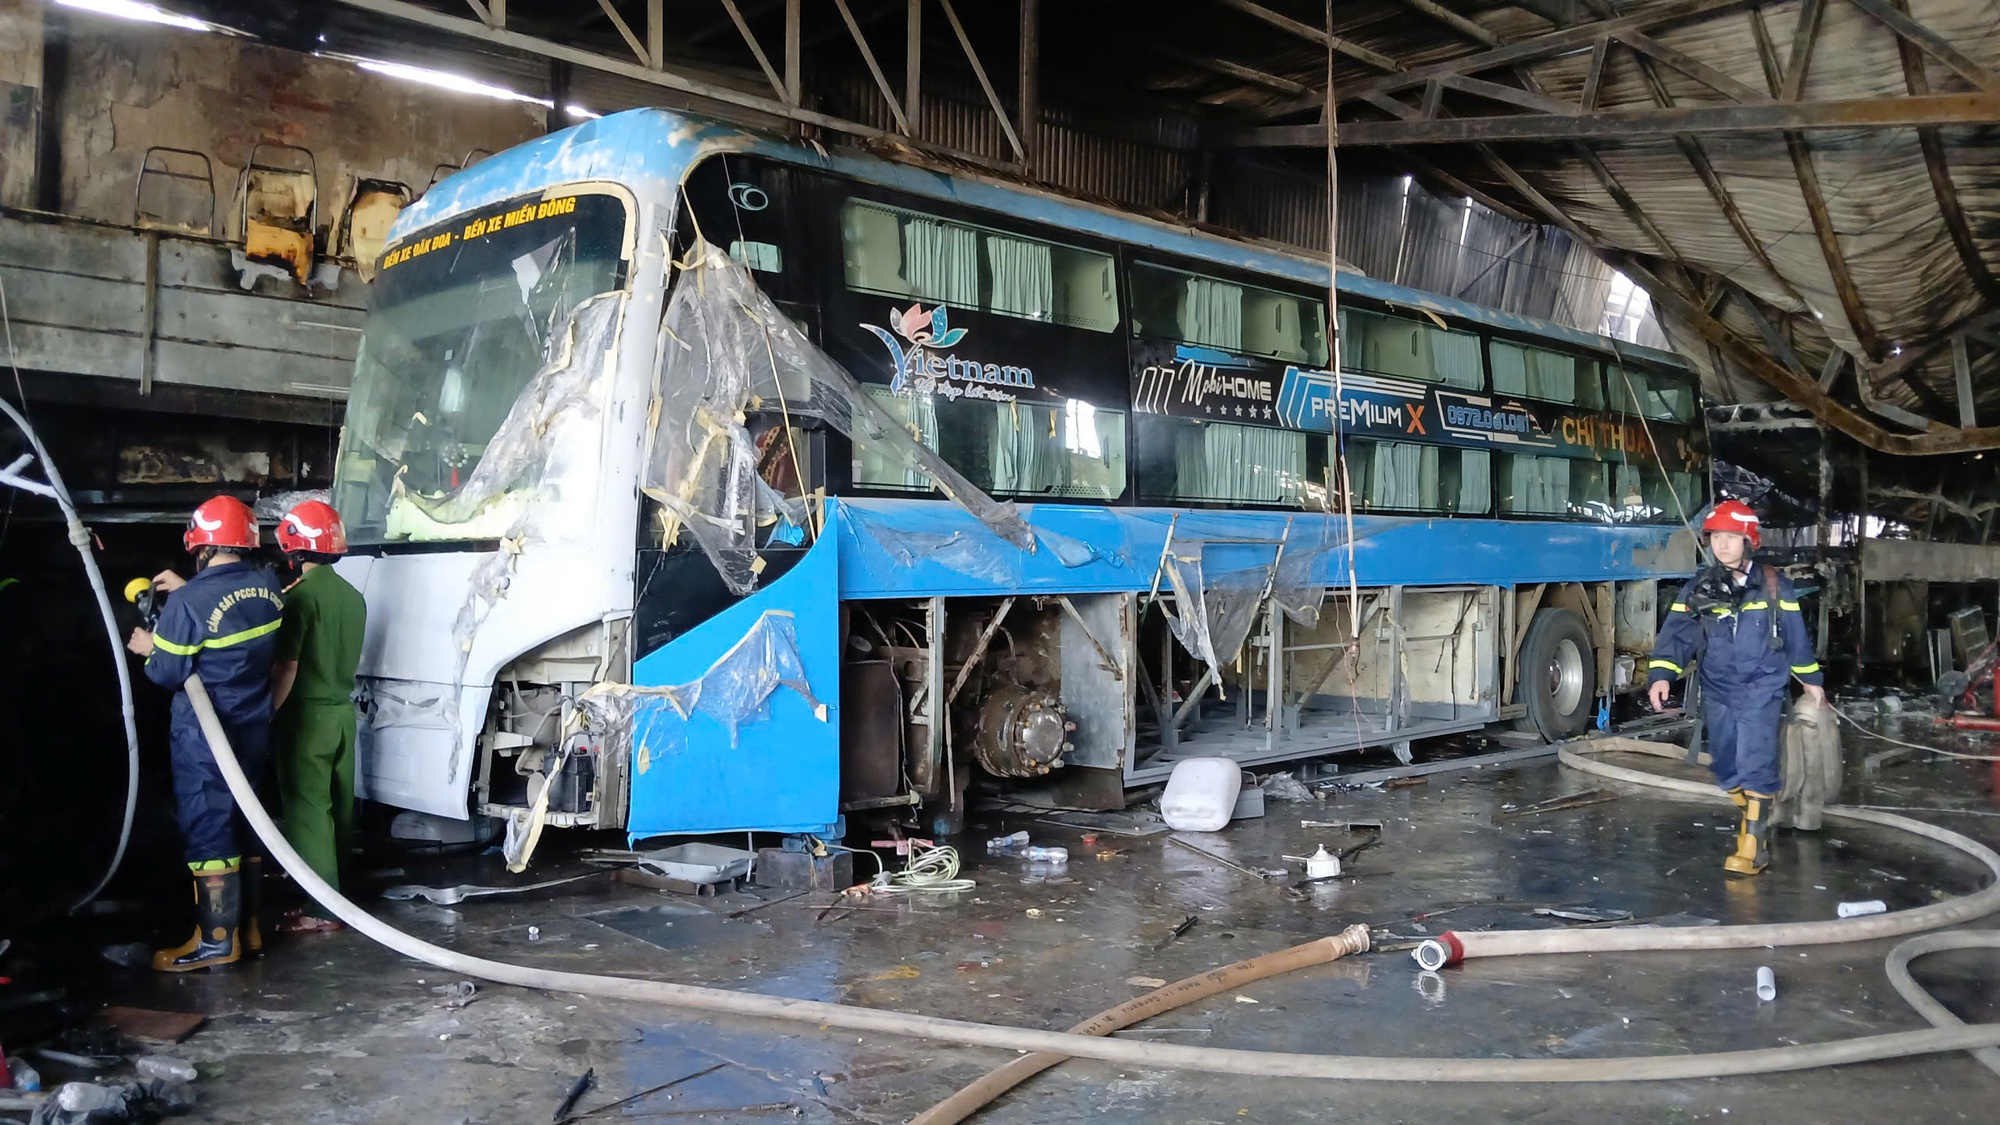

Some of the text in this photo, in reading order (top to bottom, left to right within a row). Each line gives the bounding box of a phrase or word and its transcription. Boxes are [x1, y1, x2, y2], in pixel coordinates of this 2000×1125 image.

[399, 245, 412, 263] XE
[463, 217, 486, 241] BẾN
[486, 214, 503, 233] XE
[503, 202, 537, 229] MIỀN
[537, 196, 576, 219] ĐÔNG
[858, 323, 1036, 396] Vietnam
[1311, 397, 1428, 435] PREMIUM X
[233, 587, 257, 602] PCCC
